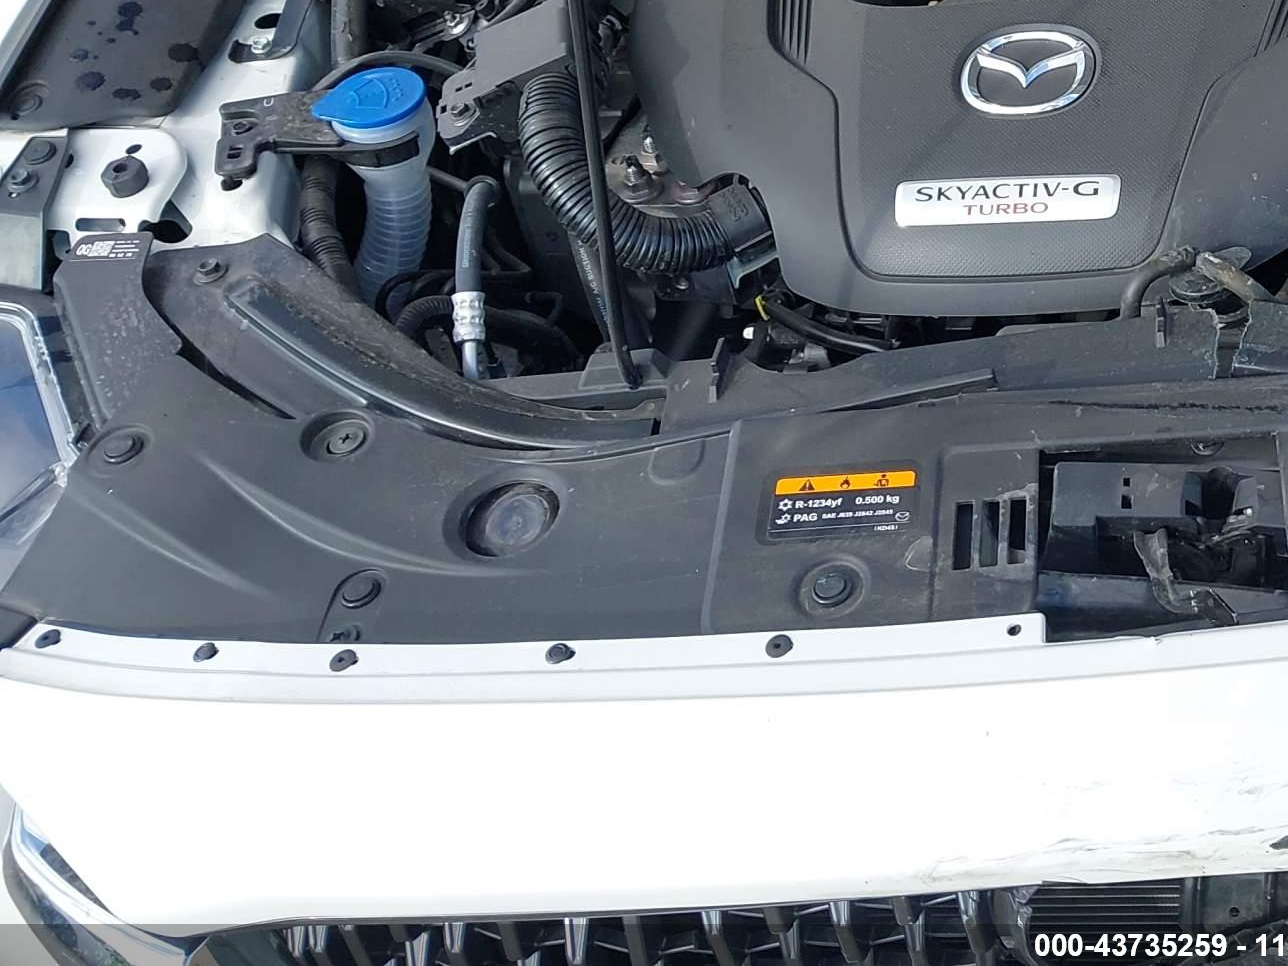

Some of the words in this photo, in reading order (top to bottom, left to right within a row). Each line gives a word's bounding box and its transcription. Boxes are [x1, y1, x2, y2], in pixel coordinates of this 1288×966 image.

[914, 180, 1100, 202] SKYACTIV-G
[962, 202, 1049, 216] TURBO
[794, 497, 843, 509] R-1234yf
[855, 495, 884, 505] 0.500
[886, 494, 900, 504] kg
[793, 512, 818, 523] PAG
